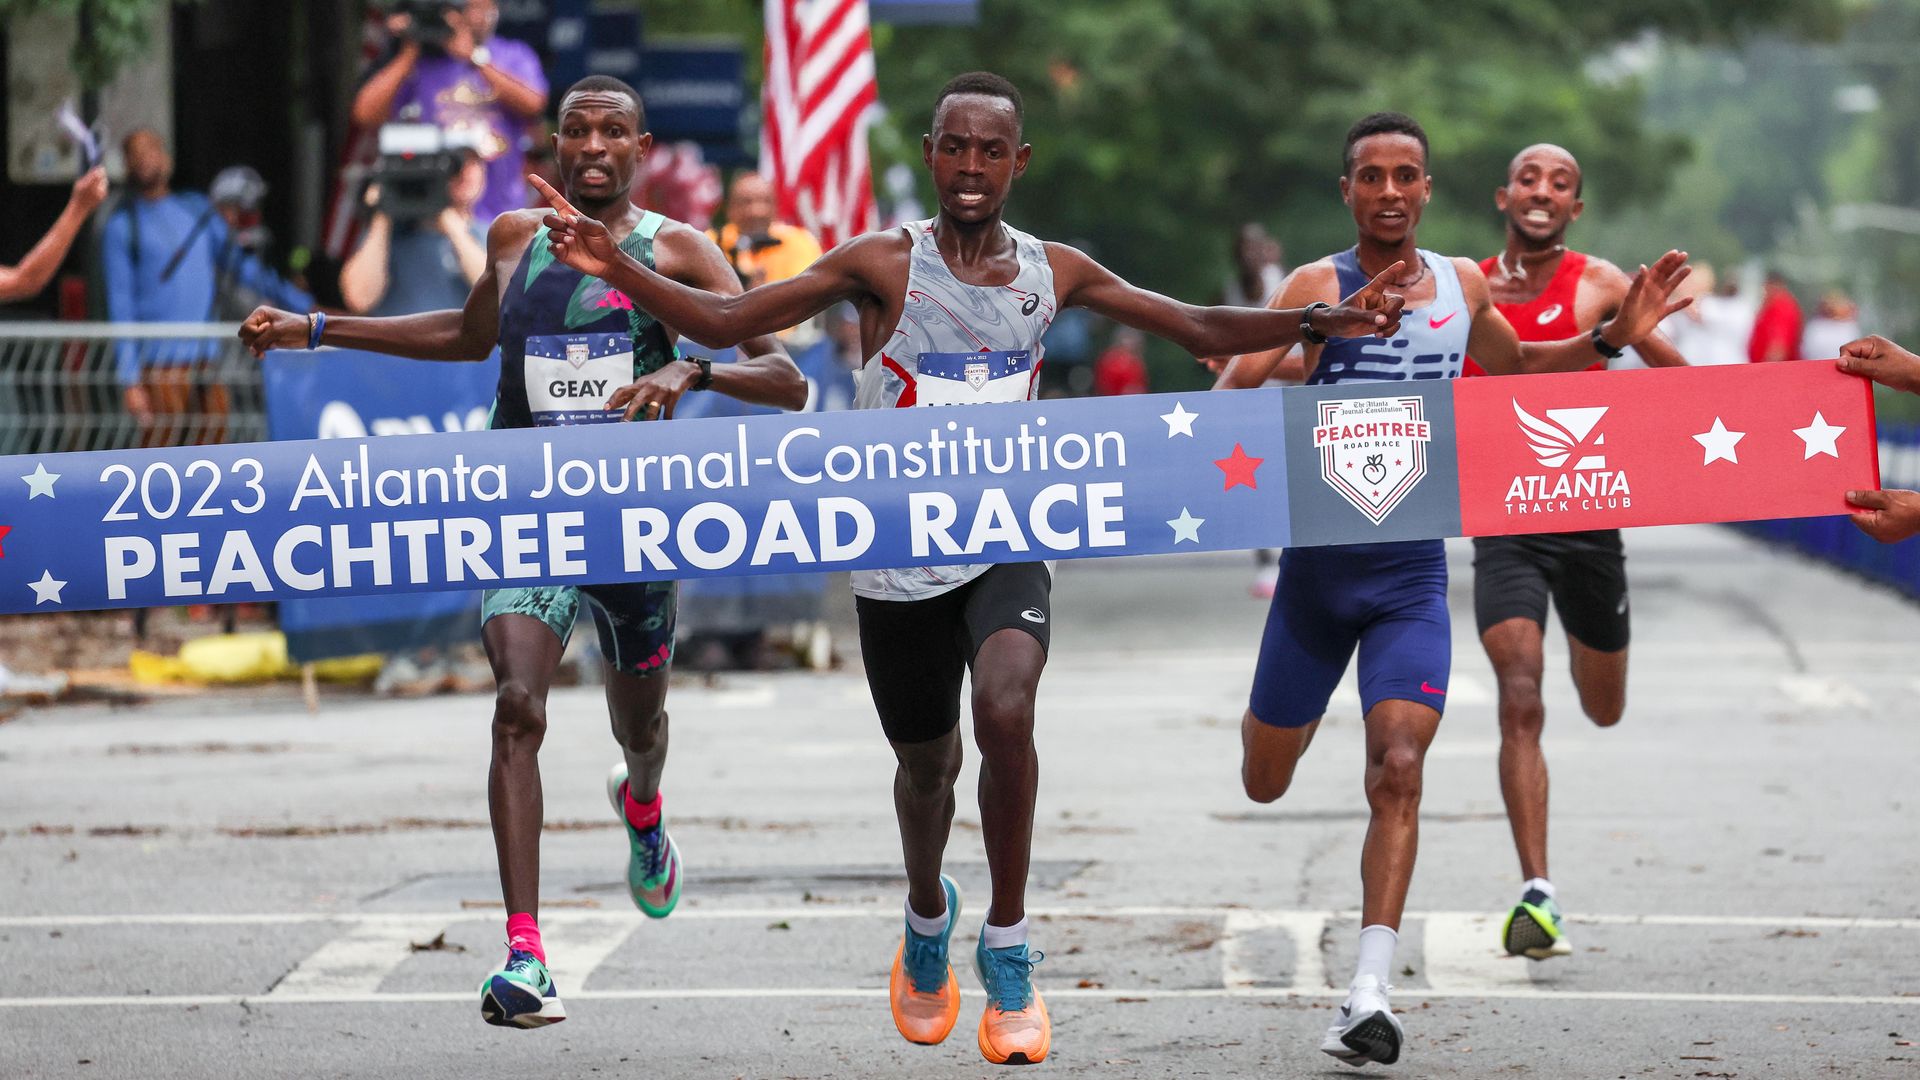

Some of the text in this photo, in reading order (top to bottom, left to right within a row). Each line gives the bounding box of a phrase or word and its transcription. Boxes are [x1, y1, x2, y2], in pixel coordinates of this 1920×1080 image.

[608, 338, 615, 347] 8
[1007, 356, 1017, 366] 16
[549, 379, 608, 398] GEAY
[1365, 400, 1389, 408] Atlanta
[1316, 422, 1428, 444] PEACHTREE
[1343, 440, 1400, 450] ROAD RACE
[99, 458, 266, 522] 2023
[289, 444, 508, 512] Atlanta
[530, 416, 1127, 499] Journal-Constitution
[1504, 470, 1631, 502] ATLANTA
[1505, 497, 1632, 515] TRACK CLUB
[104, 481, 1127, 600] PEACHTREE ROAD RACE
